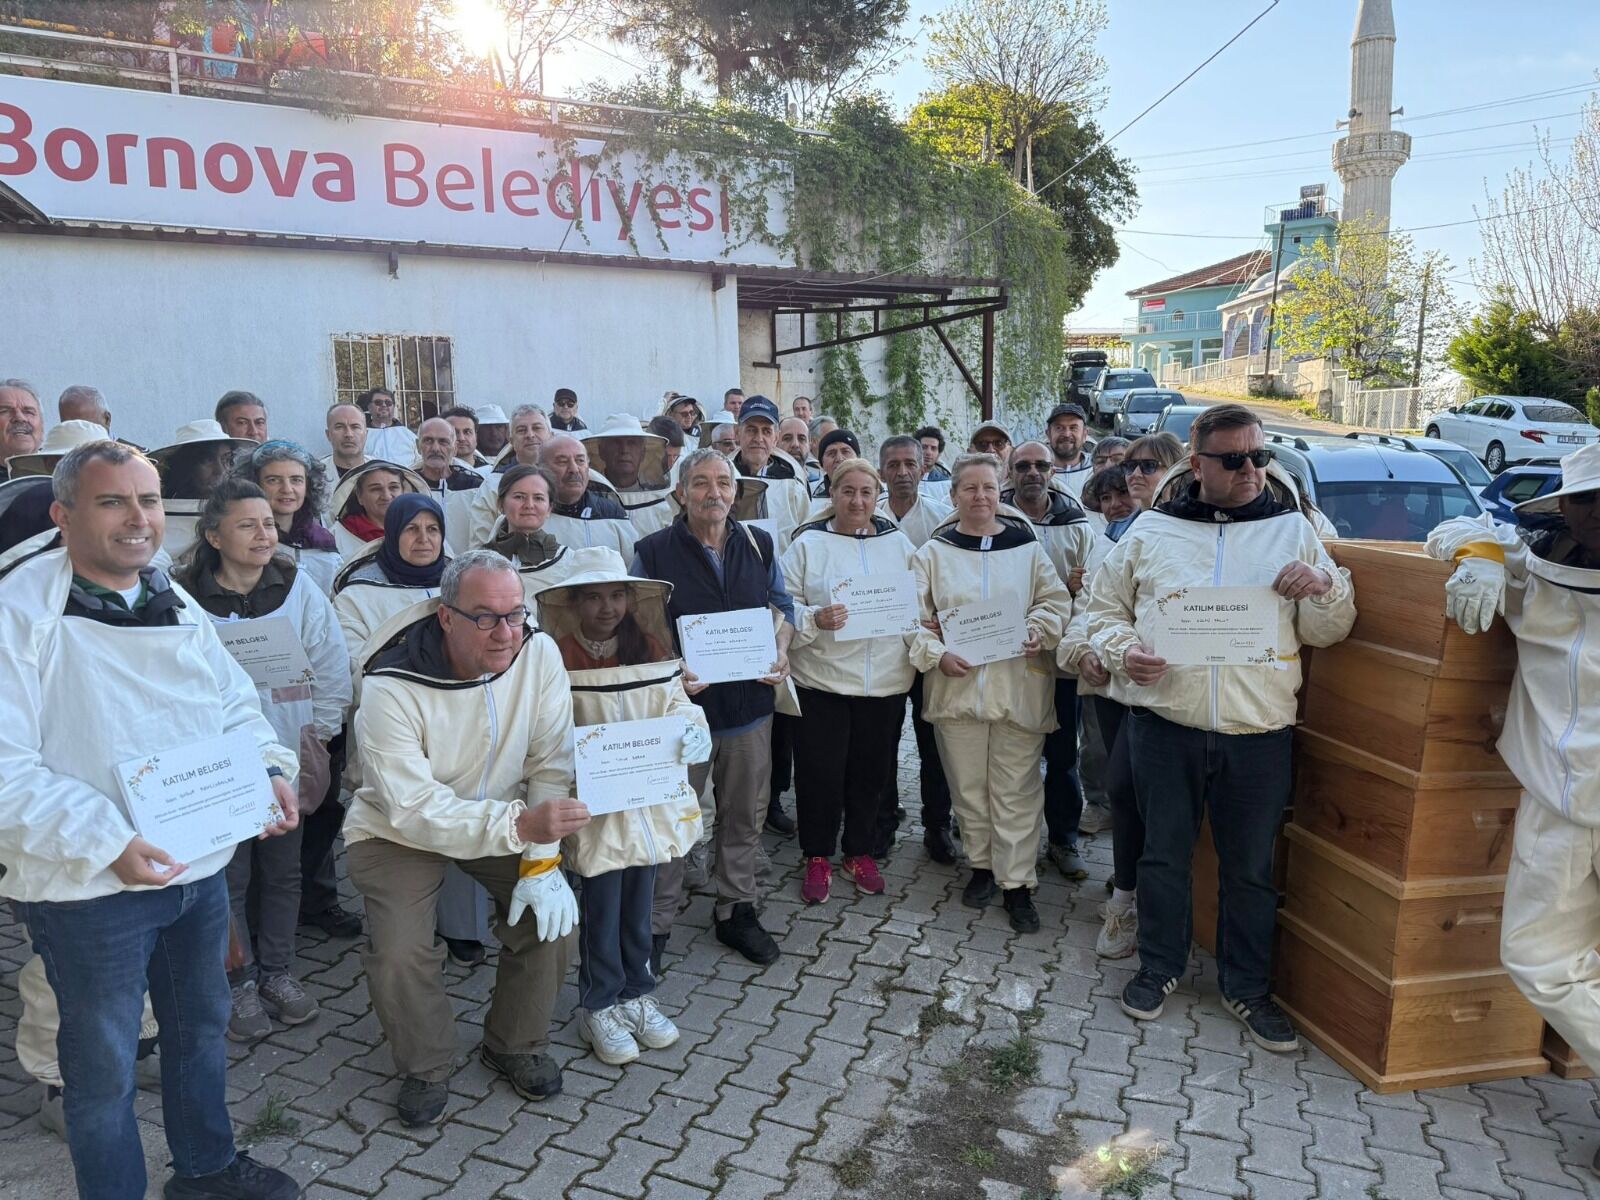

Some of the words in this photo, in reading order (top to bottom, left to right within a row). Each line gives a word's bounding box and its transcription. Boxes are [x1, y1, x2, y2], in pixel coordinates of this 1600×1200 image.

[0, 104, 356, 202] Bornova
[383, 143, 730, 241] Belediyesi
[1183, 604, 1214, 612] KATILIM
[1215, 603, 1249, 612] BELGESİ
[602, 741, 631, 752] KATILIM
[631, 736, 661, 748] BELGESİ
[161, 769, 197, 788] KATILIM
[197, 757, 232, 776] BELGESİ
